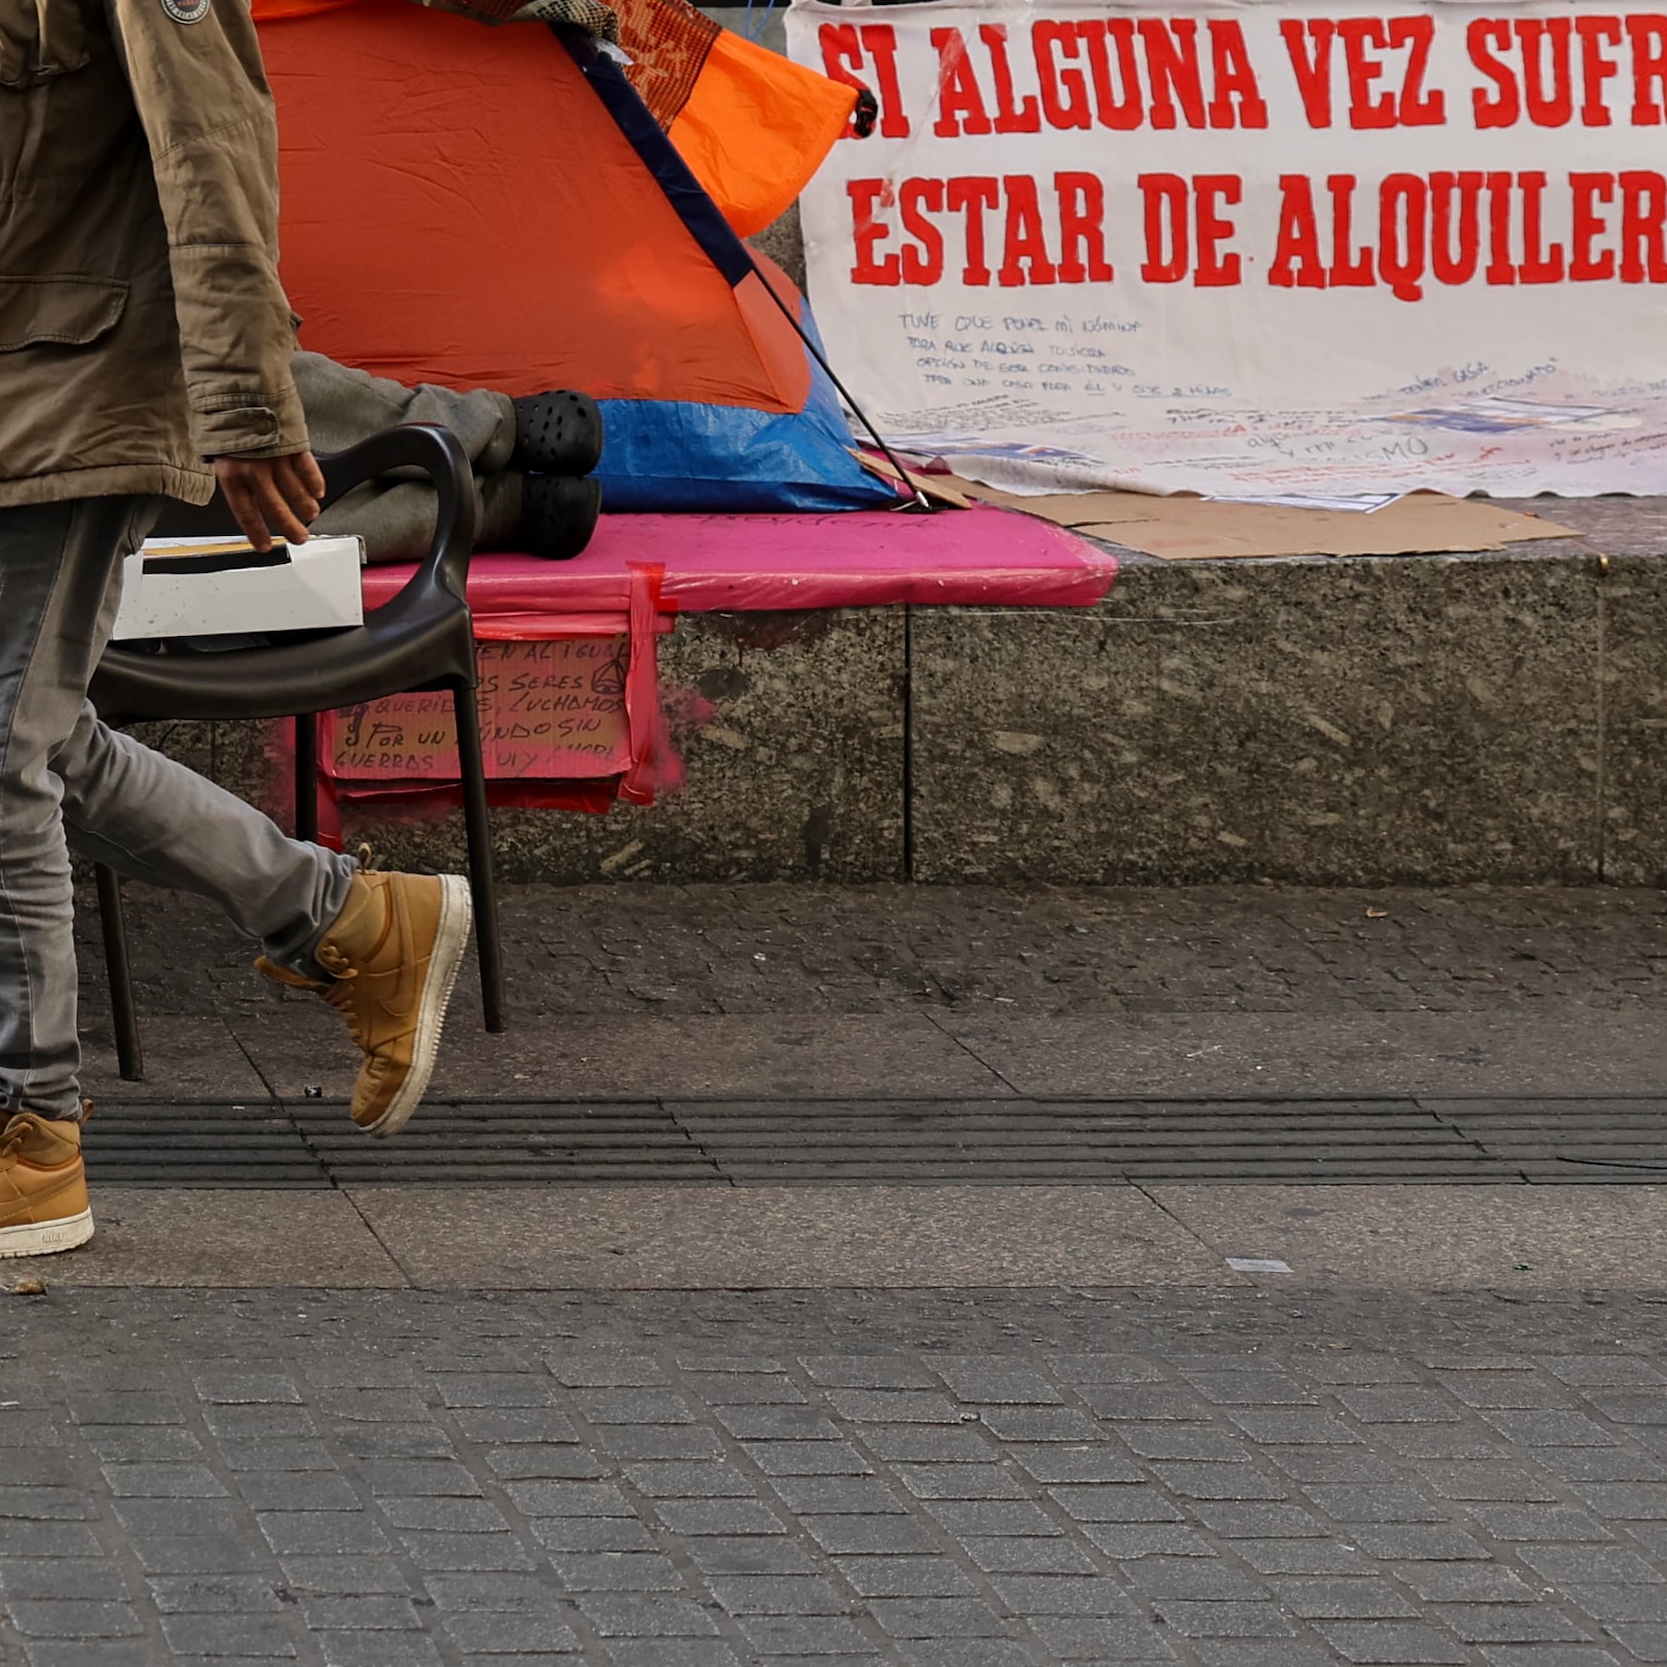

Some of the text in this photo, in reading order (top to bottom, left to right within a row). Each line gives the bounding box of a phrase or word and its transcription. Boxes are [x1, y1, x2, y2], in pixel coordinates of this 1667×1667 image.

[819, 21, 911, 139] SI
[930, 17, 1266, 137] ALGUNA
[1280, 15, 1446, 129] VEZ
[845, 167, 1667, 303] ESTAR DE ALQUILER
[955, 315, 993, 332] QUE
[508, 674, 582, 693] SERES
